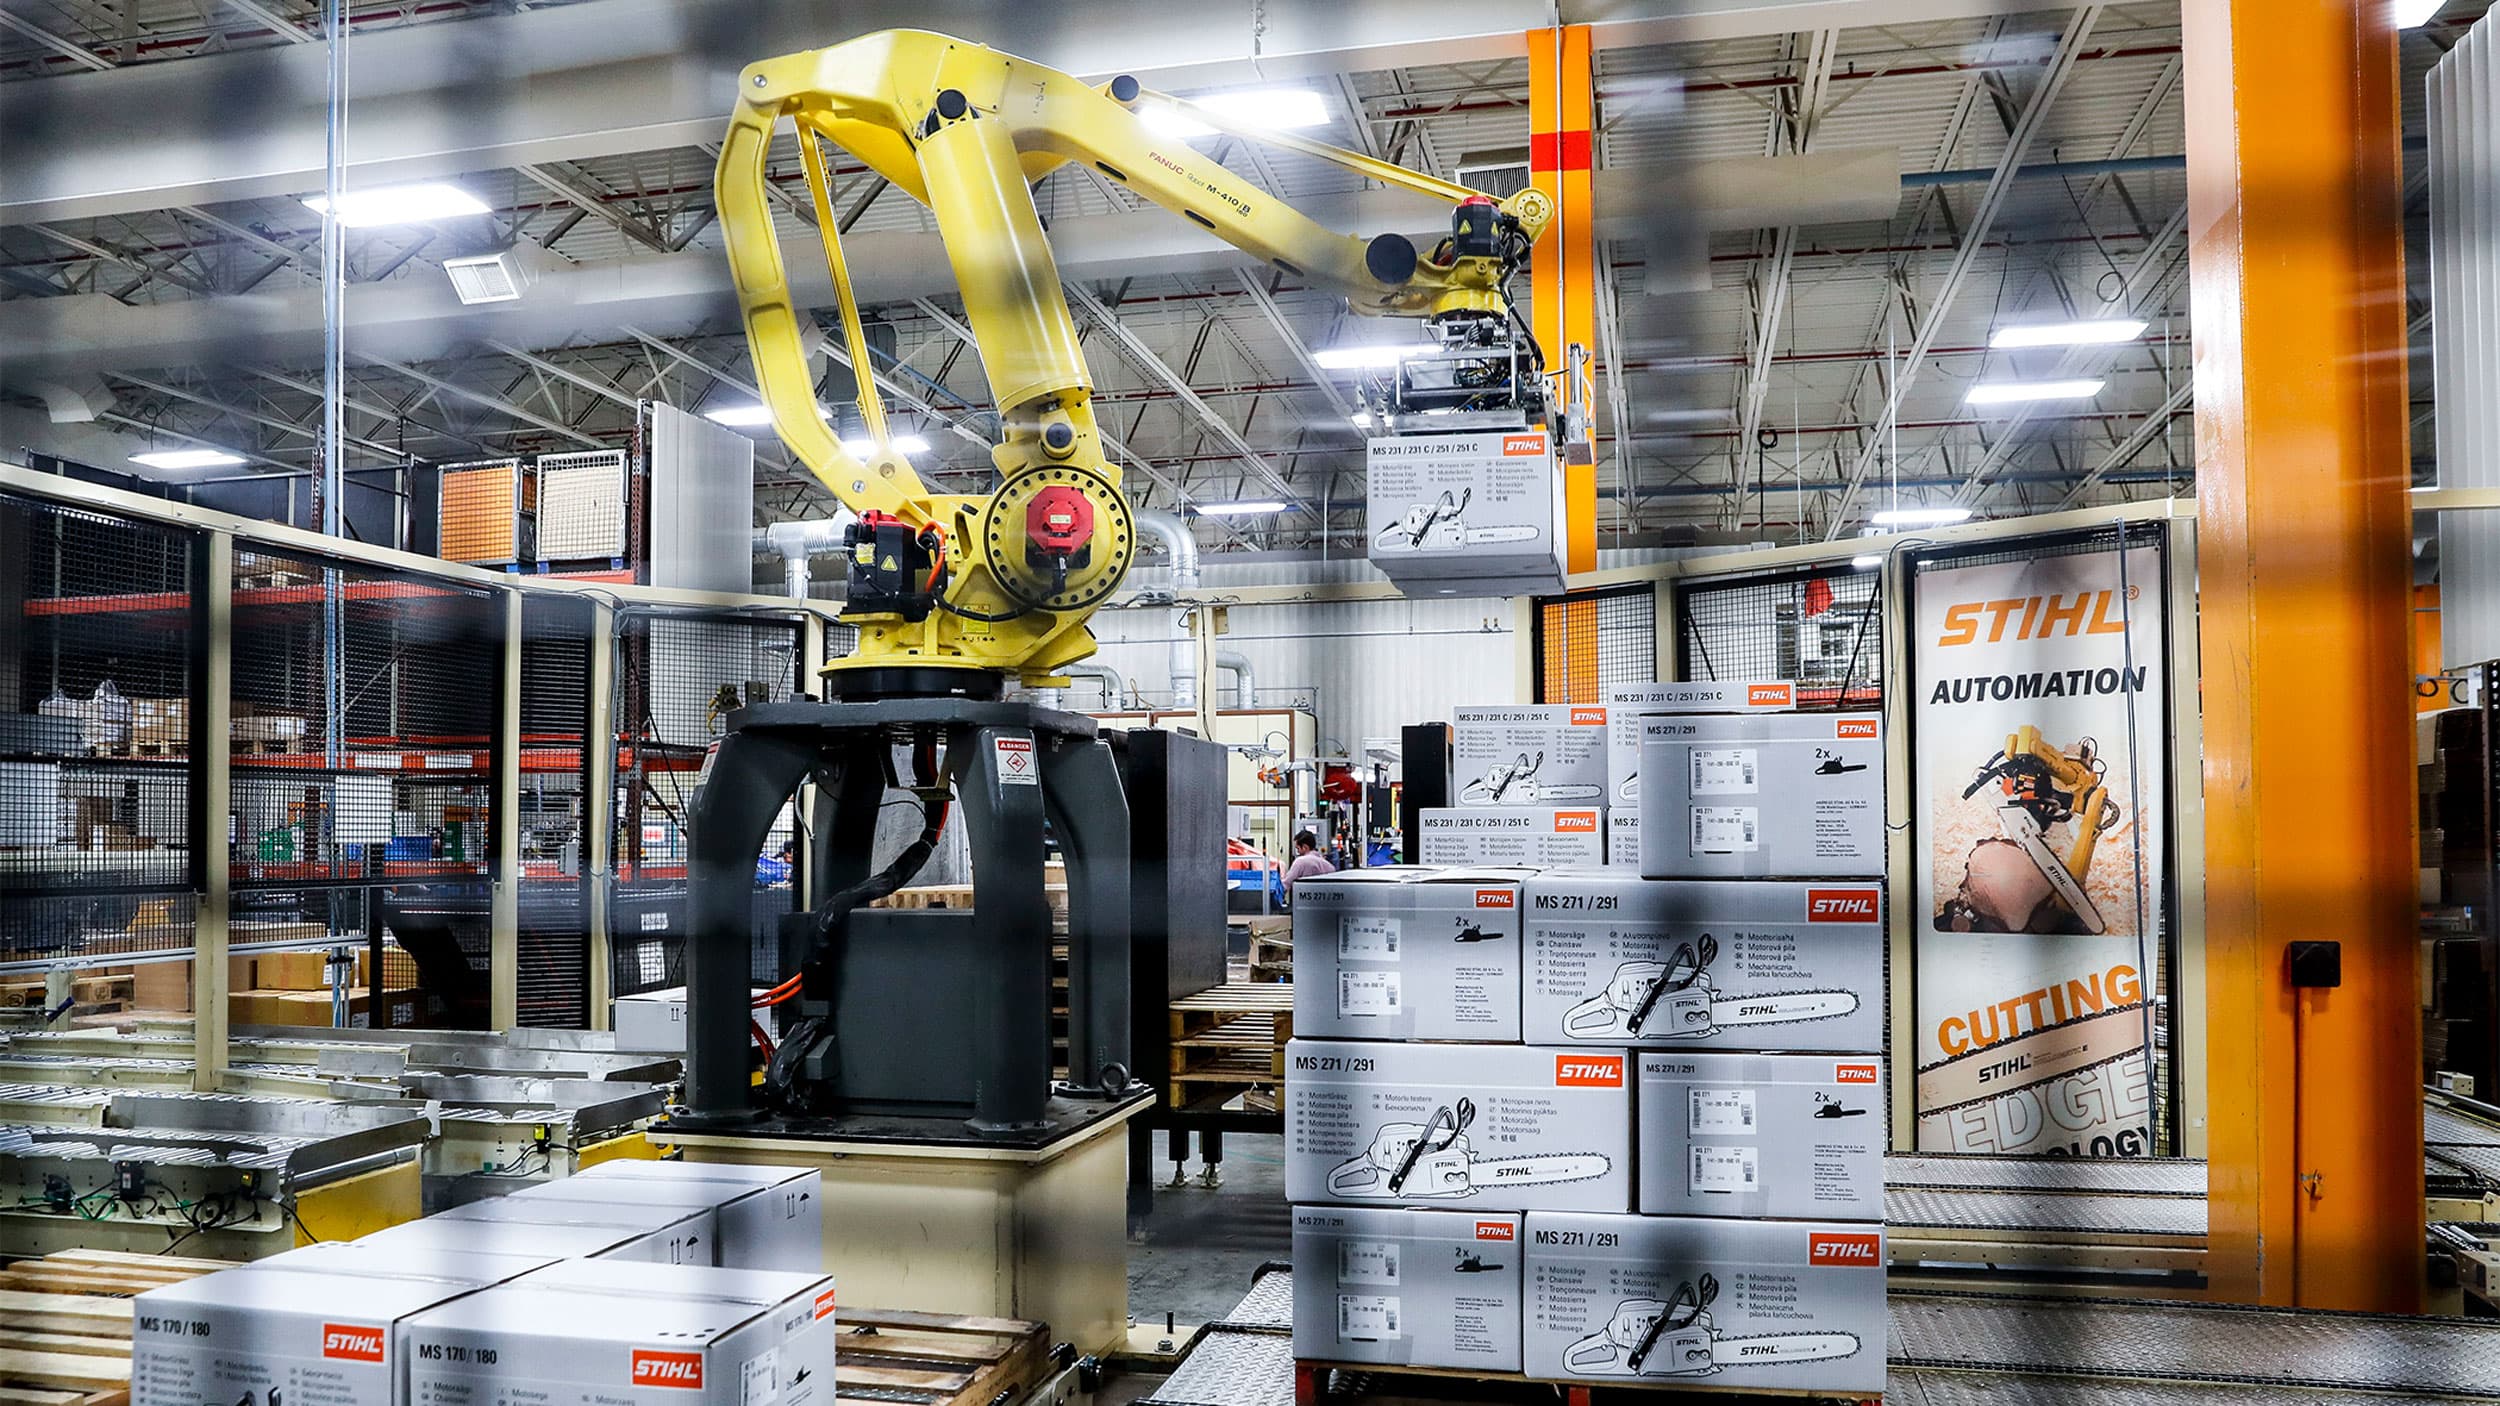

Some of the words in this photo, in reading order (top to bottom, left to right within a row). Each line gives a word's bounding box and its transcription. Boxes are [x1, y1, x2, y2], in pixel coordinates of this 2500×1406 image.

[1149, 152, 1184, 175] FANUC
[1372, 447, 1387, 456] MS
[1388, 447, 1401, 455] 231
[1403, 446, 1407, 455] /
[1408, 446, 1422, 454] 231
[1424, 445, 1429, 454] C
[1430, 445, 1435, 454] /
[1436, 444, 1449, 453] 251
[1451, 444, 1456, 453] /
[1456, 444, 1470, 452] 251
[1472, 443, 1478, 452] C
[1506, 440, 1541, 451] STIHL
[1938, 590, 2130, 647] STIHL
[1930, 666, 2146, 705] AUTOMATION
[1614, 694, 1628, 702] MS
[1646, 693, 1650, 702] /
[1667, 693, 1672, 701] C
[1674, 693, 1678, 701] /
[1695, 692, 1699, 701] /
[1717, 692, 1722, 700] C
[1751, 690, 1787, 699] STIHL
[1648, 726, 1661, 734] MS
[1663, 726, 1676, 734] 271
[1678, 726, 1681, 735] /
[1683, 726, 1696, 734] 291
[1839, 725, 1874, 733] STIHL
[1815, 748, 1822, 758] 2
[1455, 819, 1460, 828] /
[1460, 819, 1473, 827] 231
[1476, 819, 1481, 827] C
[1483, 819, 1487, 828] /
[1503, 819, 1507, 827] /
[1558, 818, 1592, 826] STIHL
[2047, 865, 2066, 887] STIHL
[1478, 895, 1511, 903] STIHL
[1536, 896, 1558, 909] MS
[1562, 896, 1583, 909] 271
[1587, 896, 1593, 910] /
[1596, 896, 1618, 909] 291
[1812, 899, 1873, 913] STIHL
[1456, 917, 1461, 926] 2
[1549, 950, 1596, 959] Tronçonneuse
[1549, 989, 1582, 997] Motosega
[1739, 1004, 1777, 1016] STIHL
[1938, 964, 2142, 1057] CUTTING
[1296, 1057, 1318, 1070] MS
[1321, 1058, 1341, 1070] 271
[1345, 1058, 1351, 1072] /
[1353, 1059, 1374, 1071] 291
[1646, 1064, 1660, 1072] MS
[1677, 1065, 1681, 1073] /
[1978, 1055, 2031, 1083] STIHL
[1559, 1064, 1618, 1078] STIHL
[1838, 1070, 1874, 1079] STIHL
[1815, 1092, 1821, 1102] 2
[1949, 1058, 2149, 1153] EDGE
[1496, 1168, 1532, 1177] STIHL
[1298, 1217, 1311, 1225] MS
[1313, 1217, 1326, 1226] 271
[1332, 1218, 1344, 1226] 291
[1478, 1226, 1511, 1236] STIHL
[1536, 1231, 1558, 1244] MS
[1562, 1232, 1584, 1245] 271
[1587, 1232, 1593, 1247] /
[1597, 1233, 1618, 1246] 291
[1455, 1247, 1461, 1257] 2
[1814, 1243, 1874, 1258] STIHL
[1549, 1276, 1582, 1285] Chainsaw
[1549, 1286, 1597, 1294] Tronçonneuse
[1549, 1295, 1586, 1303] Motosierra
[1549, 1305, 1587, 1313] Moto-serra
[1749, 1303, 1793, 1311] Mechaniczna
[1549, 1314, 1587, 1323] Motosserra
[140, 1317, 159, 1332] MS
[163, 1320, 181, 1334] 170
[183, 1321, 190, 1336] /
[190, 1321, 210, 1337] 180
[1549, 1324, 1583, 1332] Motosega
[325, 1333, 381, 1353] STIHL
[419, 1344, 442, 1360] MS
[446, 1346, 466, 1362] 170
[475, 1348, 497, 1365] 180
[1740, 1346, 1778, 1355] STIHL
[634, 1360, 699, 1380] STIHL
